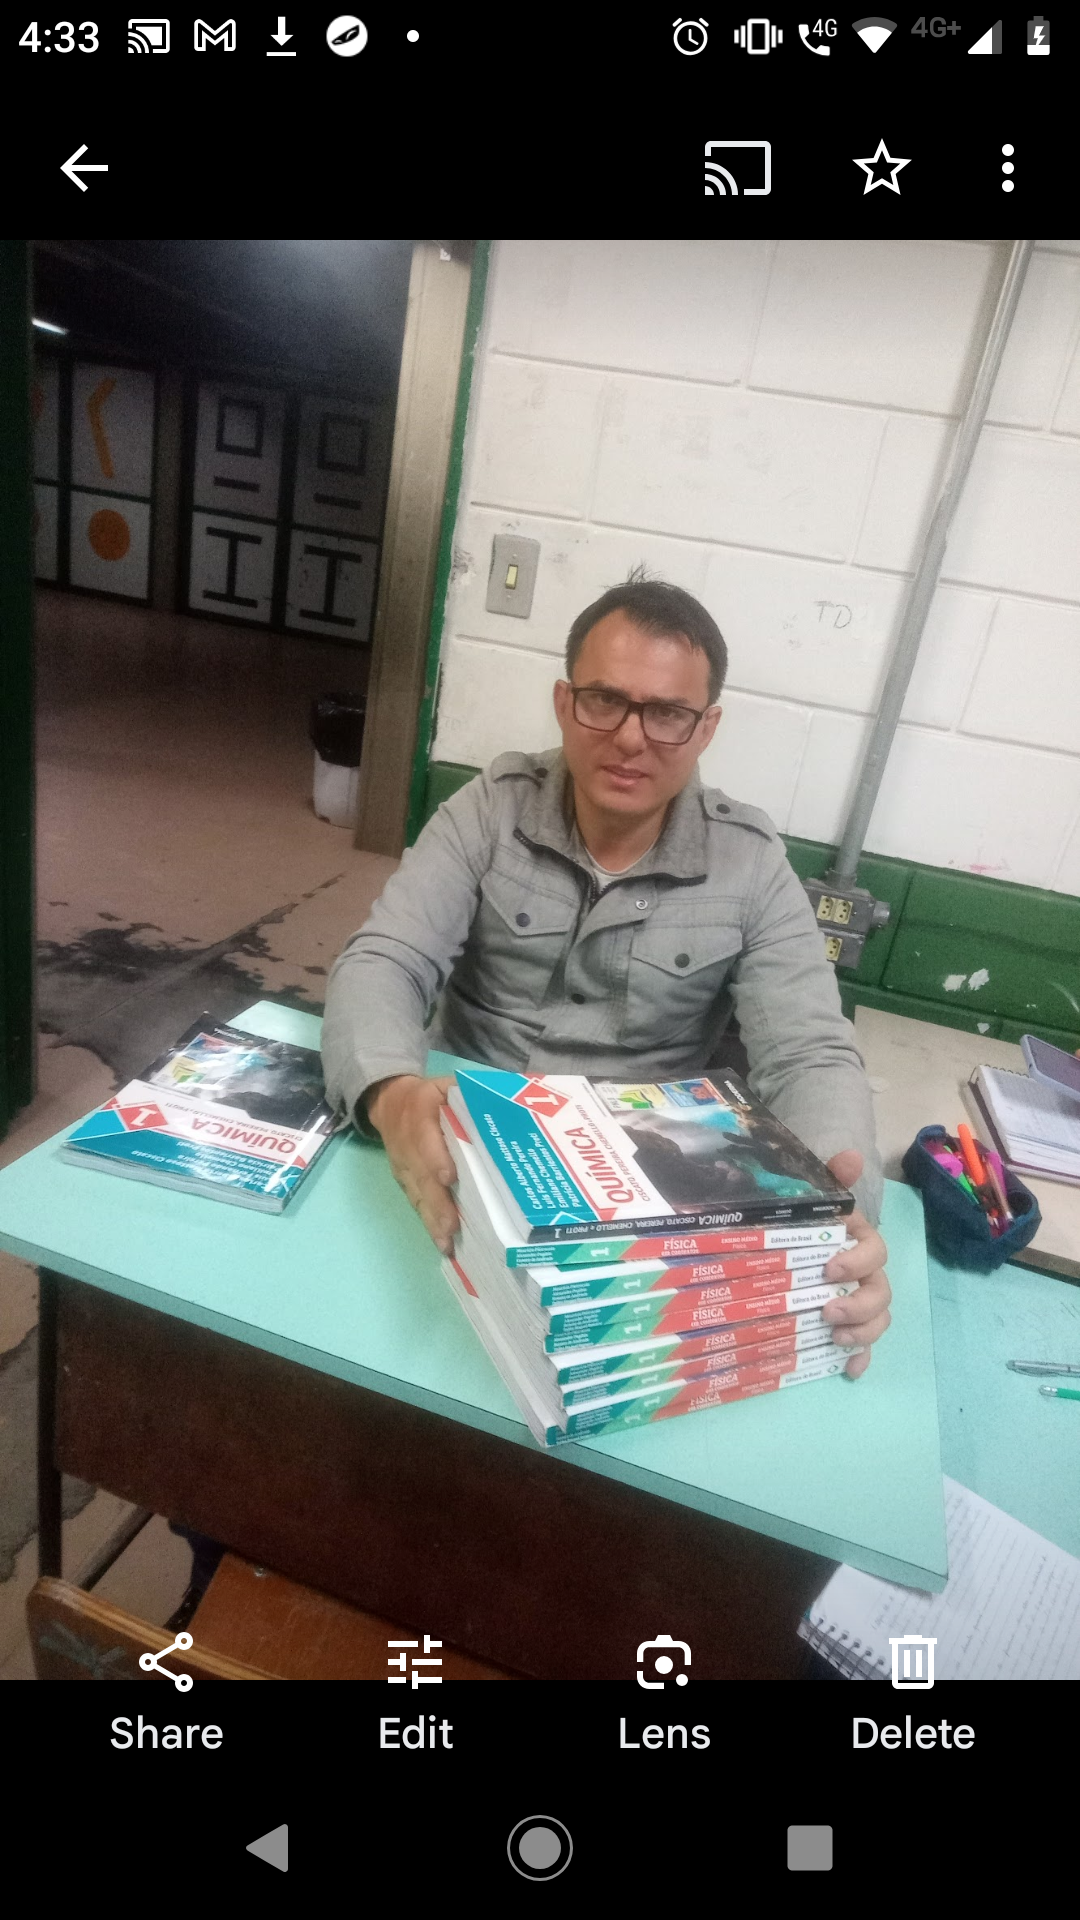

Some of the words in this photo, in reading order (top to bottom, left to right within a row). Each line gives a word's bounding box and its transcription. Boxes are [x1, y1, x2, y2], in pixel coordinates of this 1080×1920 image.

[523, 1093, 560, 1106] 1
[130, 1107, 158, 1126] 1
[484, 1113, 500, 1136] Ciscato
[192, 1118, 296, 1153] QUÍMICA
[528, 1132, 544, 1148] Proti
[496, 1137, 514, 1162] Mattoso
[510, 1141, 528, 1163] Pereira
[527, 1148, 550, 1178] Chemello
[540, 1148, 565, 1180] Barrientos
[564, 1126, 634, 1203] QUÍMICA
[510, 1162, 529, 1187] Alberto
[524, 1164, 547, 1193] Fernando
[525, 1187, 543, 1209] Carlos
[546, 1179, 569, 1208] Emiliano
[596, 1222, 633, 1232] CHEMELLO
[698, 1212, 743, 1226] QUÍMICA
[554, 1228, 562, 1238] 1
[565, 1225, 589, 1234] PROTI
[590, 1247, 610, 1257] 1
[664, 1238, 697, 1250] FÍSICA
[692, 1264, 724, 1277] FÍSICA
[623, 1279, 641, 1289] 1
[700, 1286, 731, 1300] FÍSICA
[705, 1332, 736, 1347] FÍSICA
